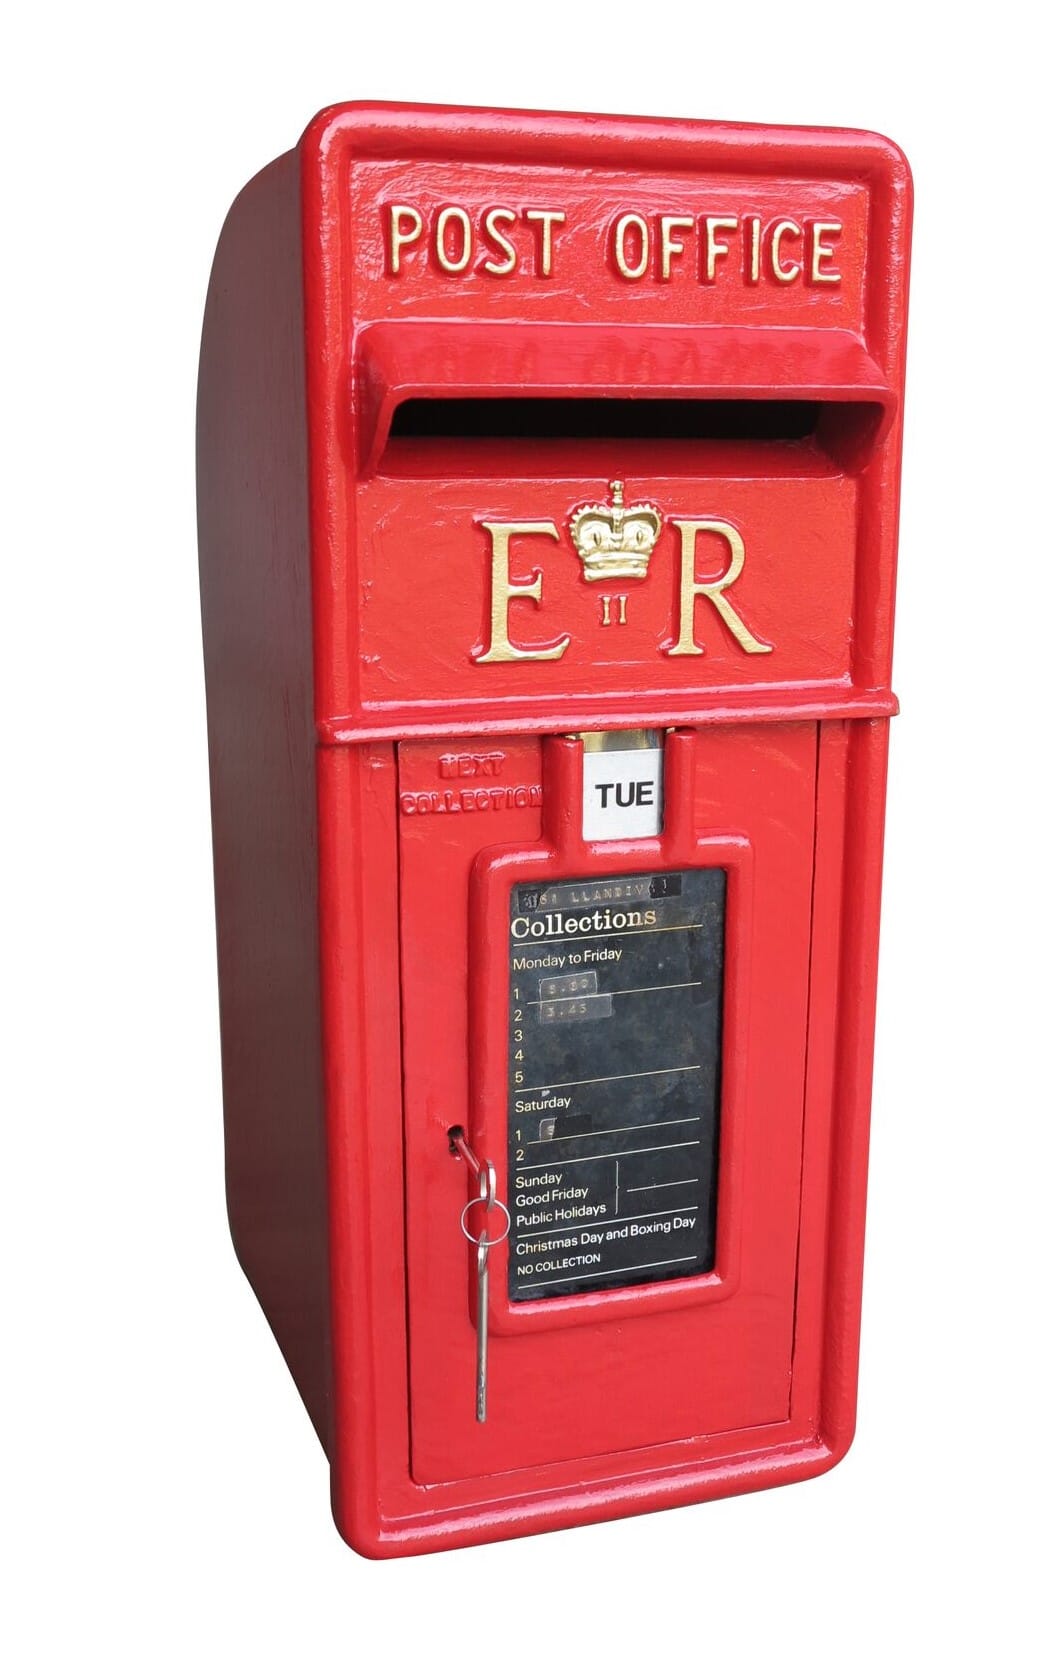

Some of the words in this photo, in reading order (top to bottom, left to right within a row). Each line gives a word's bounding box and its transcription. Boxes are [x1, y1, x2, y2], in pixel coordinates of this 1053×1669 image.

[389, 204, 566, 275] POST
[614, 213, 843, 284] OFFICE
[473, 519, 571, 664] E
[667, 519, 773, 656] R
[438, 752, 506, 779] NEXT
[400, 785, 543, 816] COLLECTION
[595, 780, 655, 809] TUE
[510, 908, 657, 938] Collections
[512, 953, 566, 971] Monday
[567, 953, 582, 966] to
[583, 947, 623, 964] Friday
[513, 987, 520, 1001] 1
[513, 1008, 523, 1022] 2
[514, 1029, 524, 1042] 3
[514, 1048, 525, 1062] 4
[514, 1070, 524, 1084] 5
[514, 1096, 572, 1113] Saturday
[515, 1129, 522, 1142] 1
[515, 1148, 525, 1162] 2
[514, 1172, 563, 1189] Sunday
[515, 1191, 550, 1207] Good
[551, 1186, 589, 1203] Friday
[516, 1211, 553, 1228] Public
[554, 1204, 607, 1222] Holidays
[515, 1236, 578, 1256] Christmas
[580, 1230, 604, 1246] Day
[605, 1225, 629, 1241] and
[630, 1221, 672, 1237] Boxing
[673, 1216, 697, 1231] Day
[517, 1264, 534, 1276] NO
[535, 1253, 601, 1273] COLLECTION
